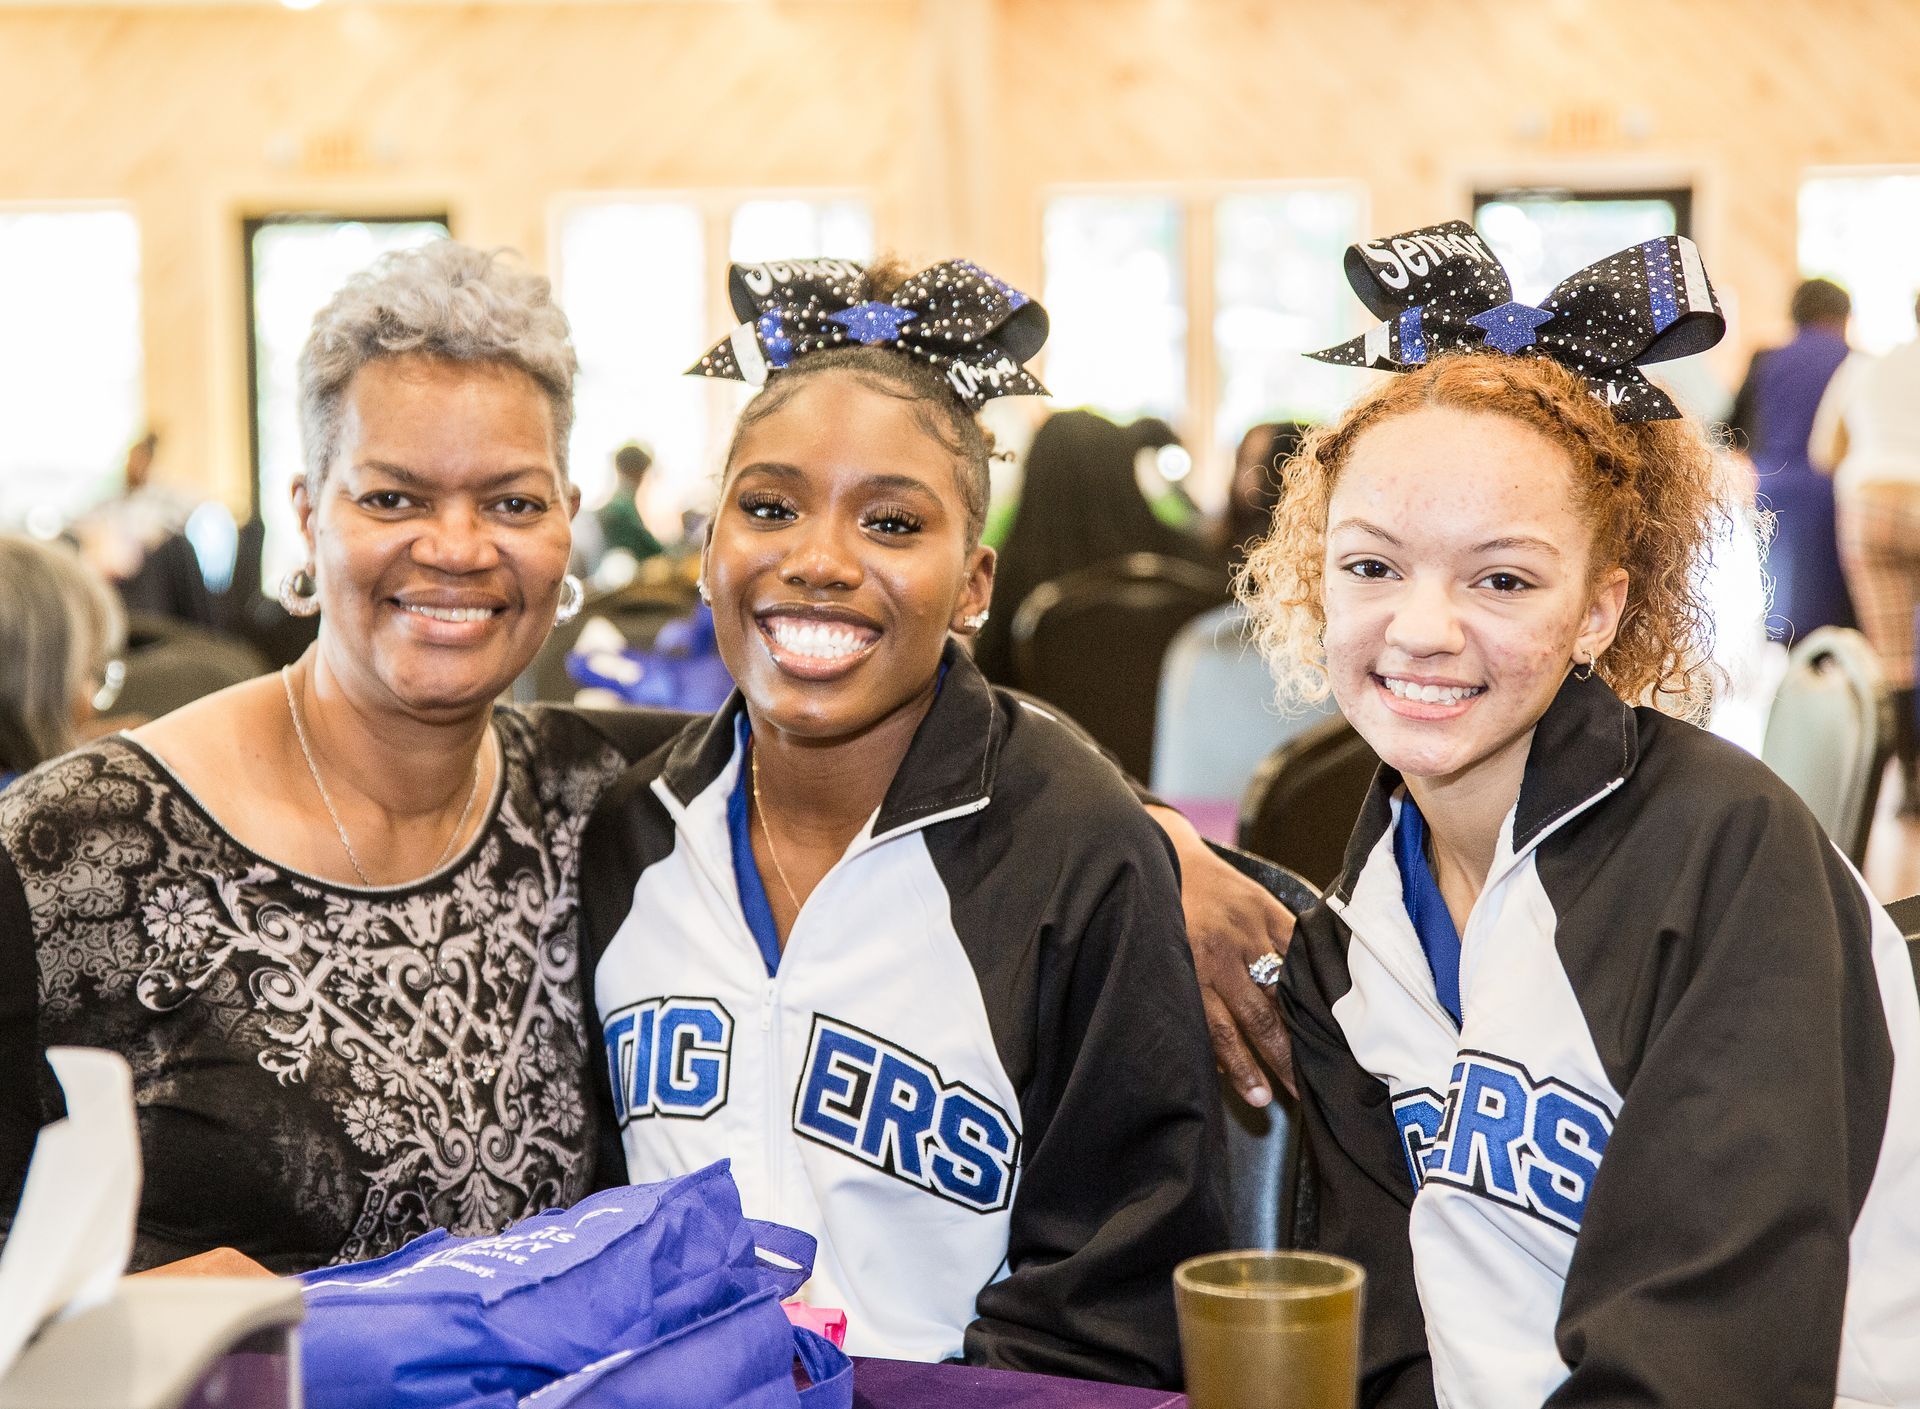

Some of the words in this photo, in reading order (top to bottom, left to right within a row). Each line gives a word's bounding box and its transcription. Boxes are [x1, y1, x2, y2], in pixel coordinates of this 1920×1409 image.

[1360, 233, 1494, 290] Senior
[794, 1012, 1022, 1215] ERS
[1423, 1048, 1618, 1240] RS
